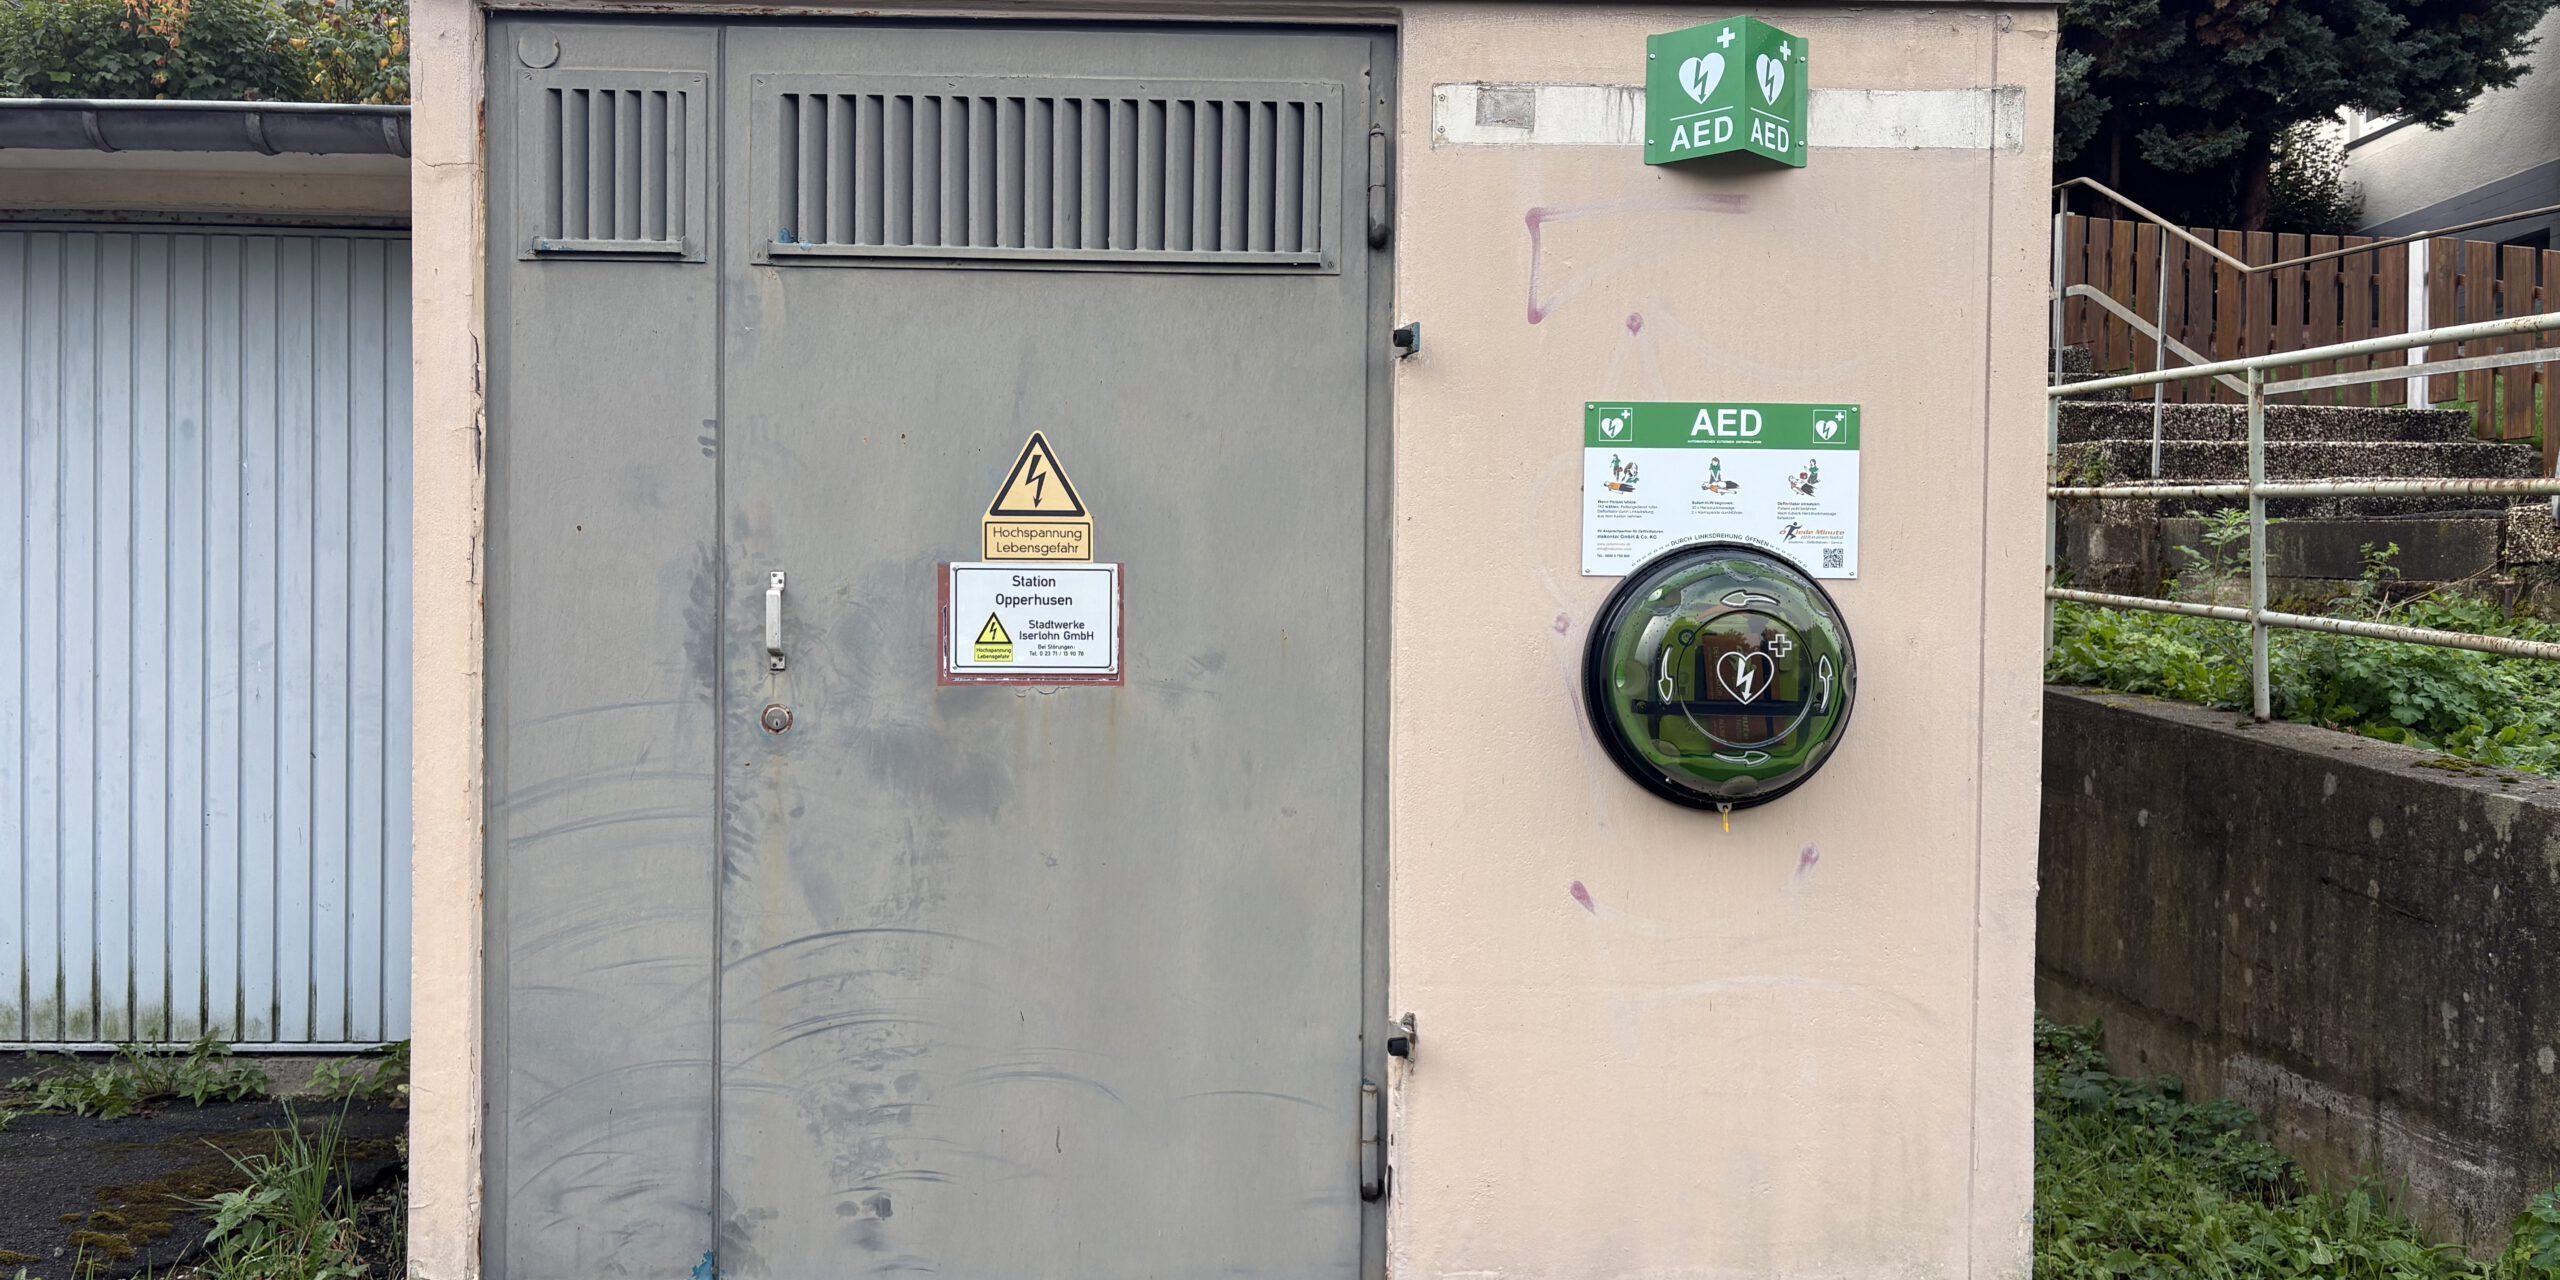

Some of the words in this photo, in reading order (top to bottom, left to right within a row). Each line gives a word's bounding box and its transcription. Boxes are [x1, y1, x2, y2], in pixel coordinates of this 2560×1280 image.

[1670, 116, 1734, 152] AED
[1751, 118, 1789, 152] AED
[1690, 408, 1763, 437] AED
[993, 526, 1082, 542] Hochspannung
[1671, 535, 1693, 546] DURCH
[1694, 532, 1743, 541] LINKSDREHUNG
[1745, 533, 1769, 547] ÖFFNEN
[996, 542, 1079, 556] Lebensgefahr
[1012, 574, 1056, 588] Station
[995, 593, 1073, 609] Opperhusen
[1028, 619, 1085, 630] Stadtwerke
[1019, 630, 1060, 641] Iserlohn
[1063, 630, 1094, 641] GmbH
[1047, 643, 1075, 651] Störungen:
